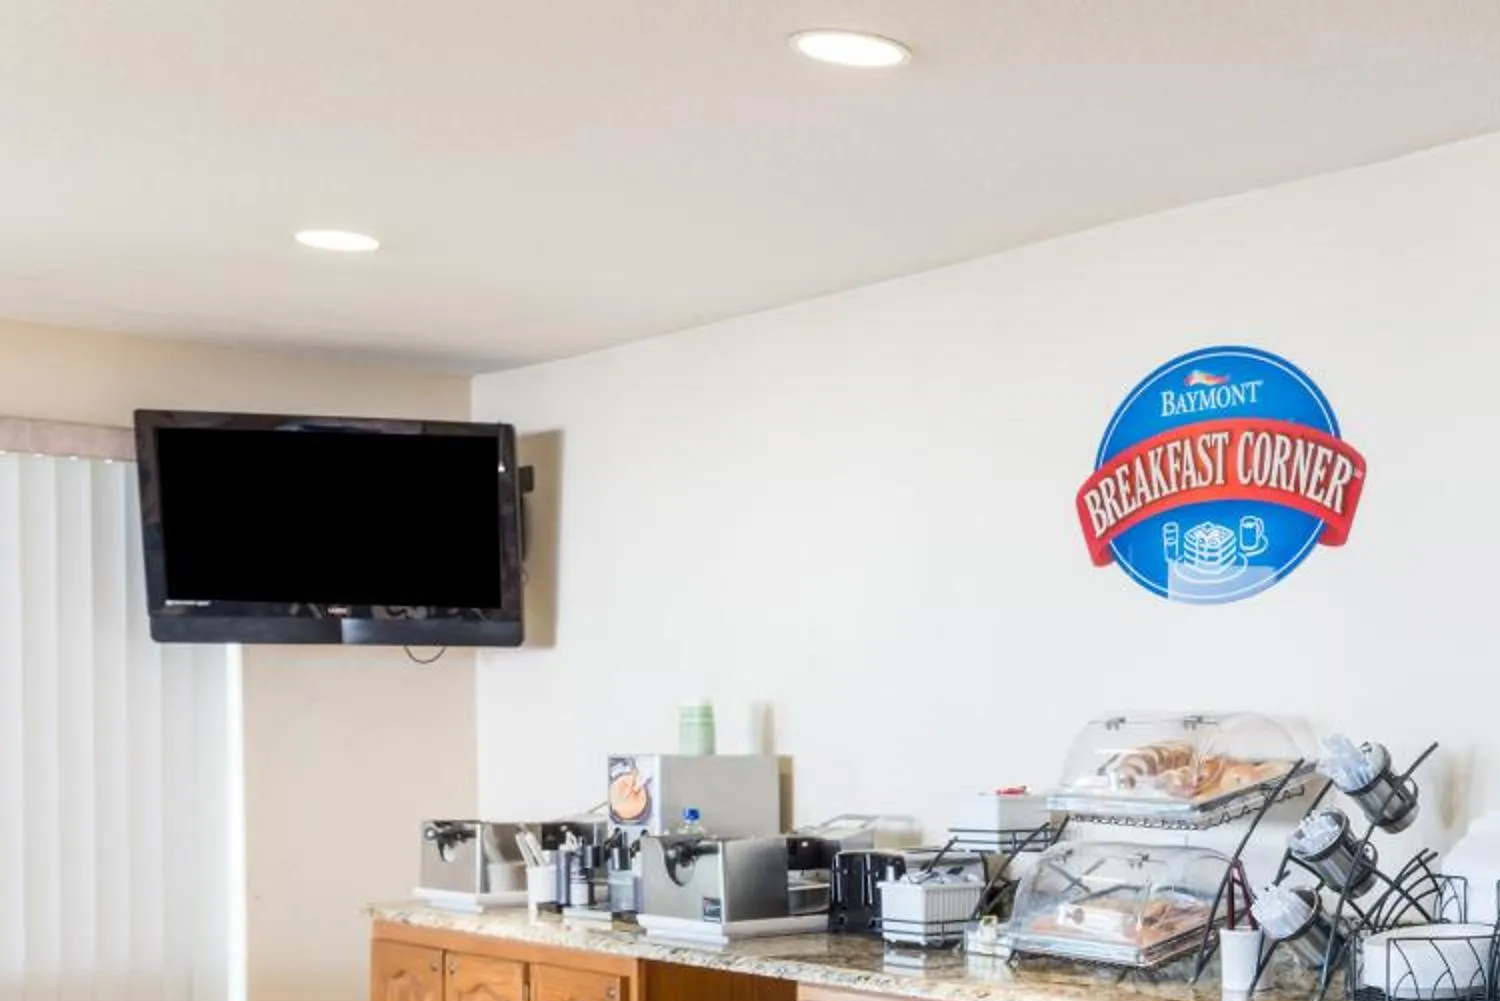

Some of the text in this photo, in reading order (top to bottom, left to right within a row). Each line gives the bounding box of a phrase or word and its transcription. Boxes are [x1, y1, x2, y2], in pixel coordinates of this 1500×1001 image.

[1160, 379, 1264, 417] BAYMONT
[1083, 430, 1353, 539] BREAKFAST CORNER
